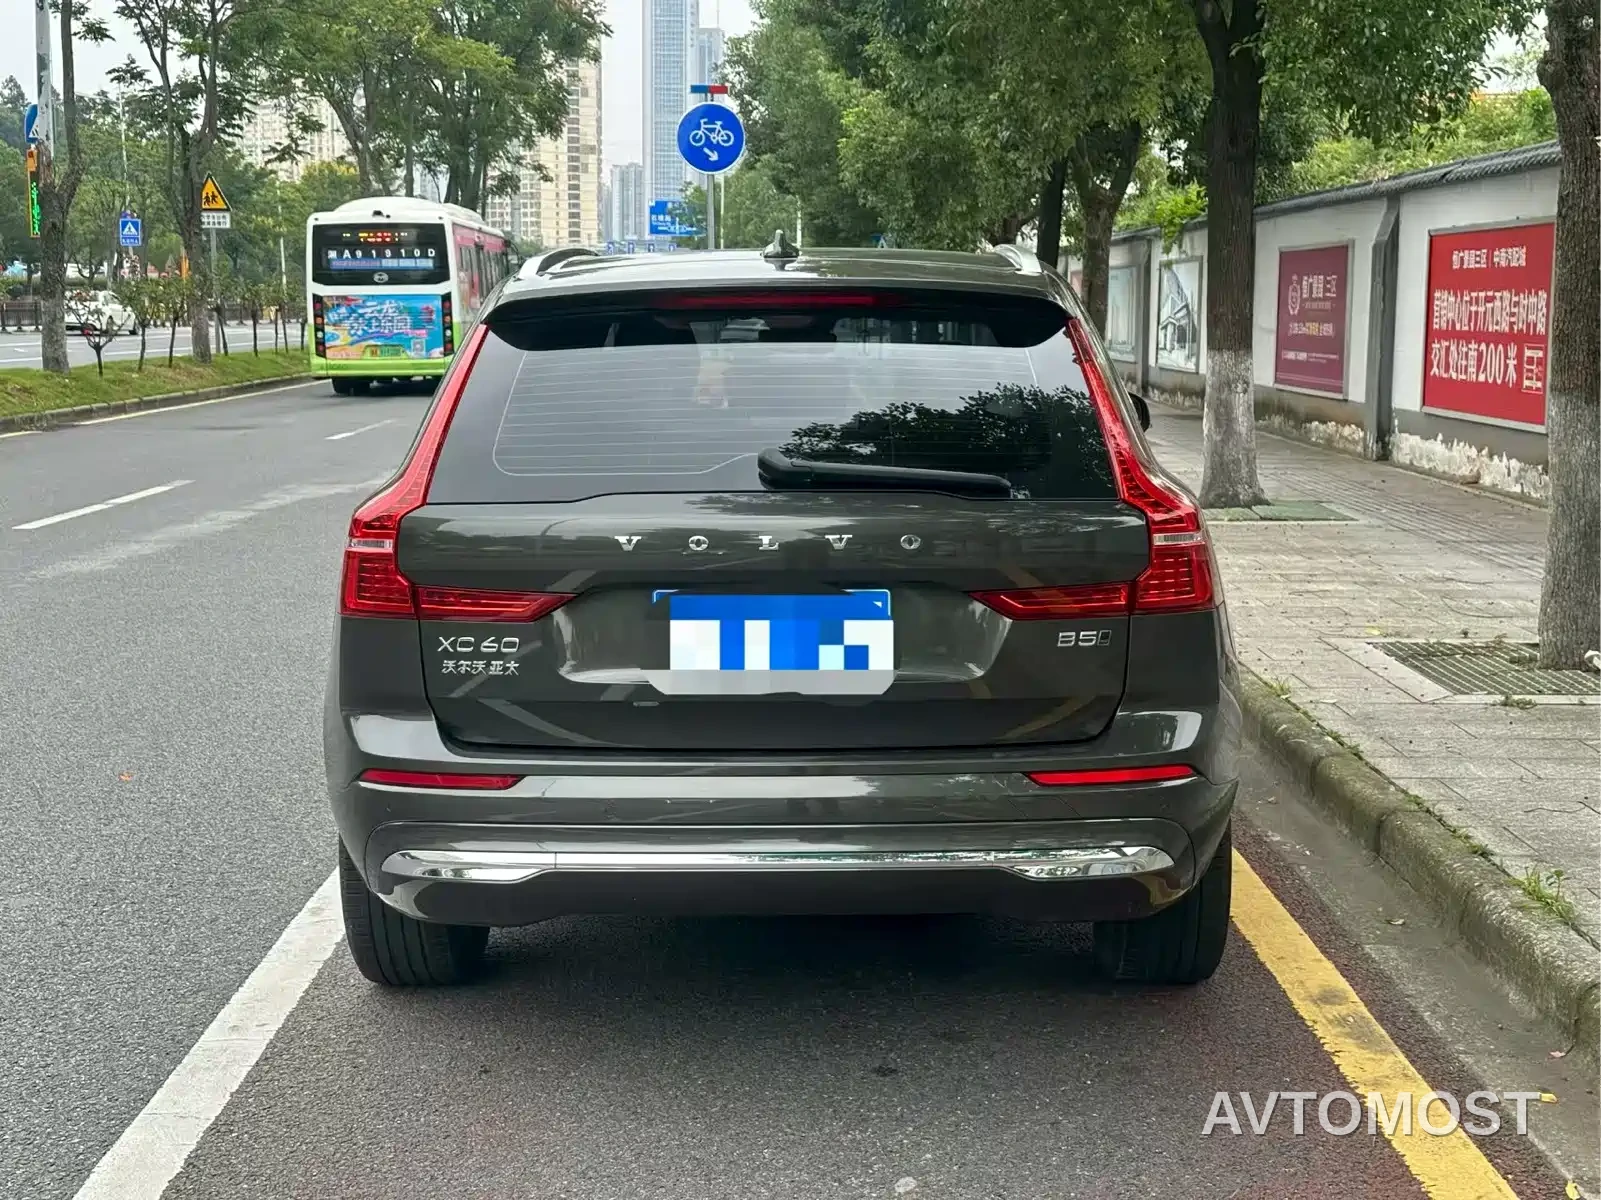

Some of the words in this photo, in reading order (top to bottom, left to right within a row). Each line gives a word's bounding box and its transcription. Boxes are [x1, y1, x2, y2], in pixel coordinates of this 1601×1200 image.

[614, 533, 922, 552] VOLVO
[441, 659, 520, 676] 沃尔沃亚太
